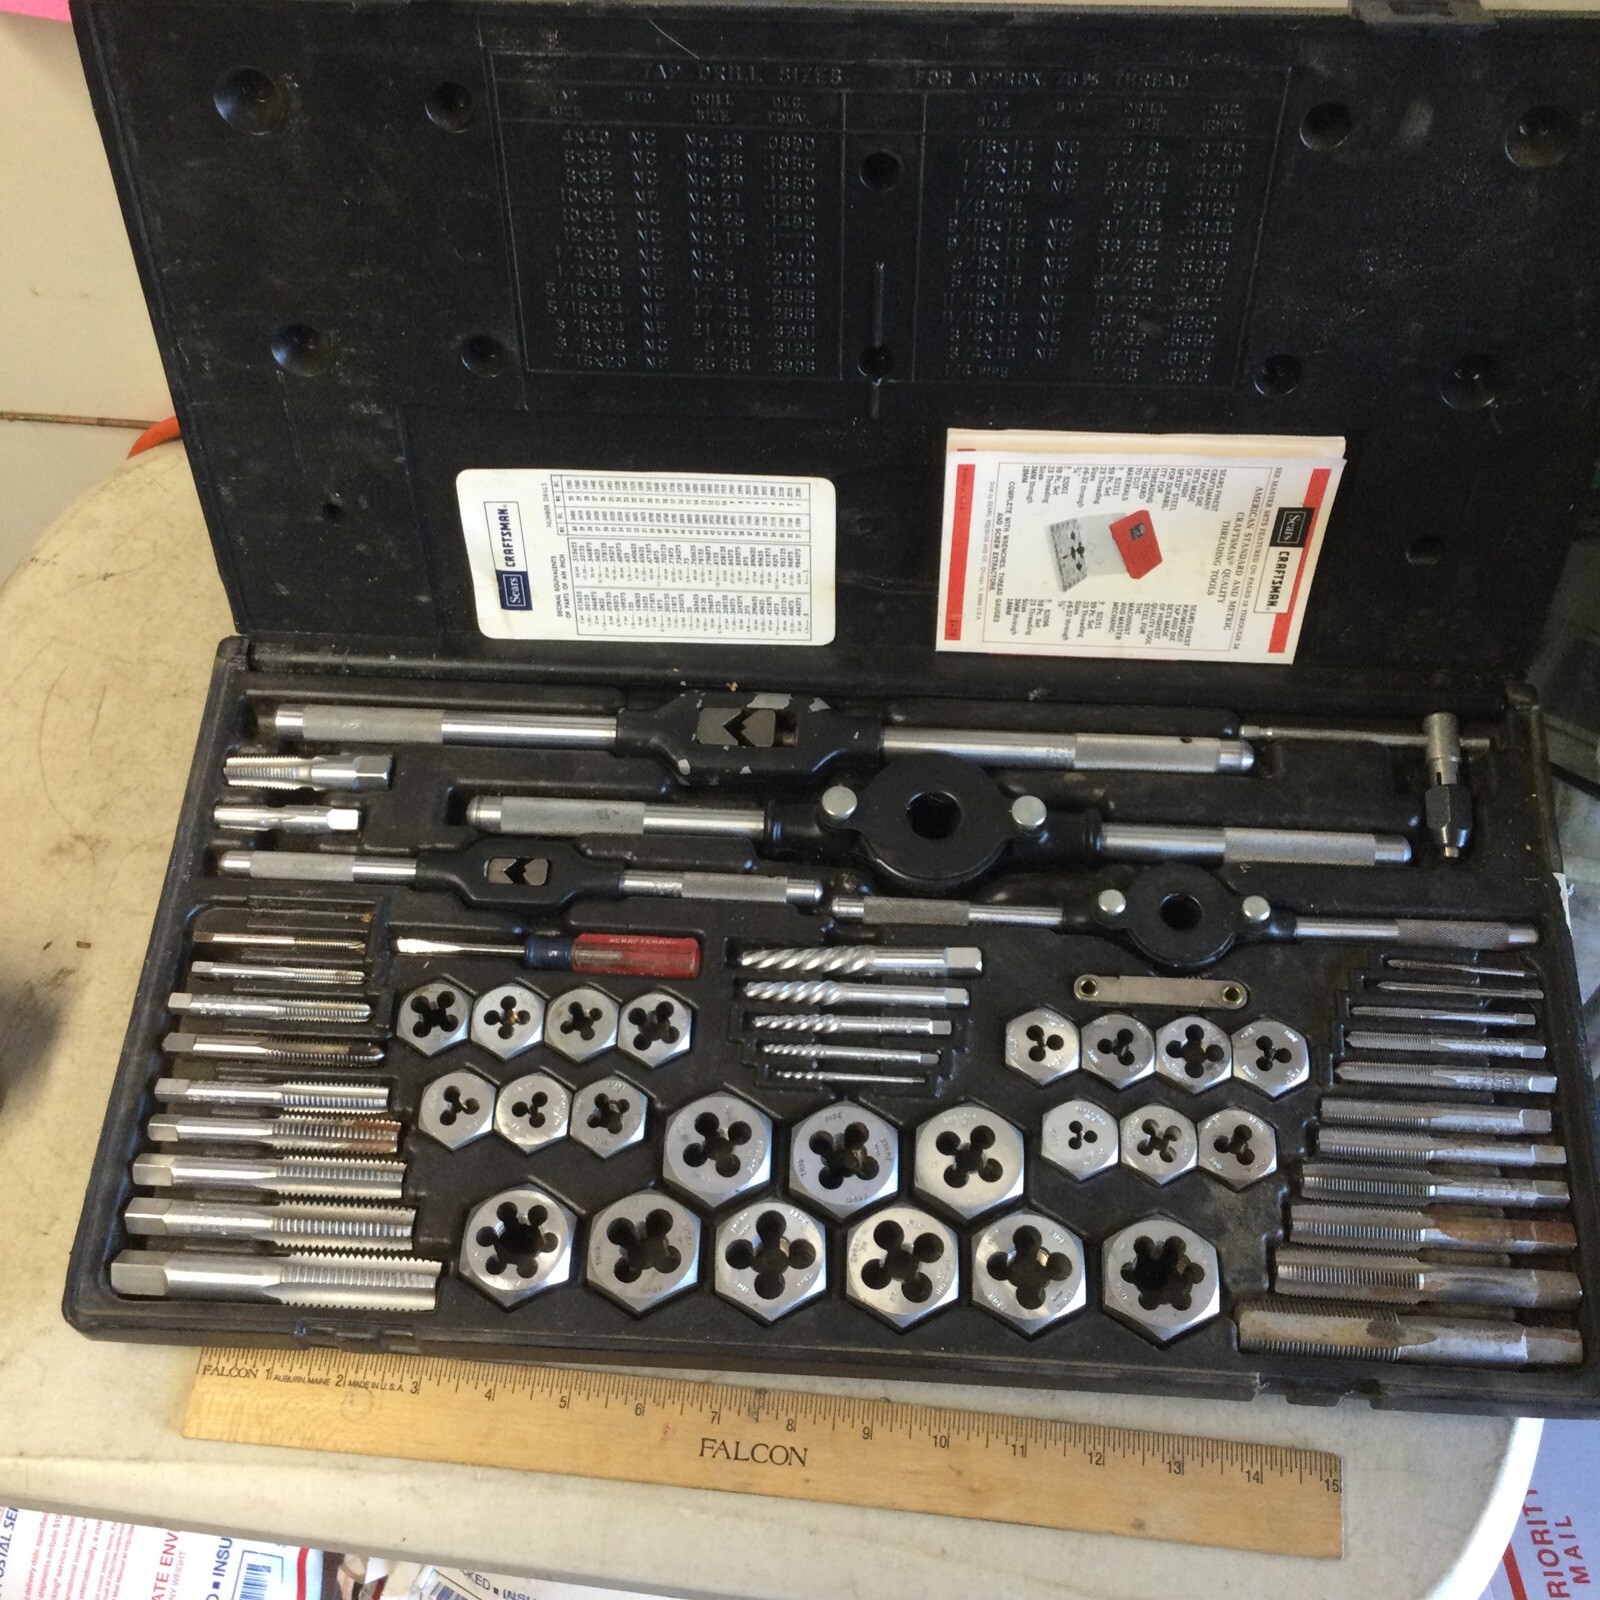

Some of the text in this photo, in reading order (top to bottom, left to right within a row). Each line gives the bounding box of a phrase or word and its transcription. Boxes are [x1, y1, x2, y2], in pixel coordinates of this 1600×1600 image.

[1121, 466, 1134, 501] MATERIALS
[1131, 467, 1142, 489] TO CUT
[1138, 467, 1150, 499] THE HARD
[1145, 467, 1159, 503] THREADING
[1156, 480, 1164, 493] FOR
[1166, 467, 1176, 480] FOR
[1184, 468, 1192, 476] OF
[1187, 468, 1201, 502] SETS MADE
[1194, 468, 1209, 506] TAP AND DIE
[1004, 481, 1015, 514] COMPLETE
[1041, 474, 1053, 503] Threading
[1075, 485, 1086, 507] through
[1092, 476, 1105, 504] Threading
[1168, 493, 1179, 511] STEEL
[1210, 469, 1226, 511] SEARS FINEST
[1264, 480, 1278, 507] MASTER
[543, 504, 552, 526] NUMBER
[995, 512, 1003, 524] AND
[1003, 517, 1011, 532] WITH
[1260, 510, 1270, 526] SETS
[992, 528, 1001, 548] SCREW
[1251, 528, 1266, 562] FEATURED
[497, 508, 521, 603] Sears CRAFTSMAN
[1206, 520, 1230, 595] THREADING TOOLS
[1222, 486, 1263, 630] AMERICAN STANDARD AND METRIC
[1249, 565, 1257, 574] ON
[1265, 514, 1302, 607] Sears CRAFTSMAN
[550, 555, 563, 616] DECIMAL EQUIVALENTS
[995, 572, 1004, 595] THREAD
[1216, 568, 1232, 603] QUALITY
[1243, 577, 1254, 598] PAGES
[565, 610, 571, 618] OF
[992, 598, 1001, 622] GAUGES
[1076, 610, 1088, 637] Threading
[1108, 602, 1119, 633] MECHANIC
[1114, 602, 1127, 640] AND MASTER
[1123, 602, 1134, 635] MACHINIST
[1134, 602, 1142, 614] THE
[1138, 602, 1150, 634] STEEL FOR
[1144, 602, 1158, 645] QUALITY TOOL
[1153, 603, 1166, 639] OF HIGHEST
[1161, 603, 1174, 637] SETS MADE
[1170, 617, 1179, 630] AND
[1173, 604, 1181, 615] TAP
[1182, 604, 1197, 646] SEARS FINEST
[1234, 609, 1247, 640] THROUGH
[202, 1364, 260, 1380] FALCON
[348, 1380, 370, 1390] MADE
[334, 1373, 344, 1388] 2
[410, 1380, 419, 1395] 3
[484, 1389, 493, 1402] 4
[558, 1396, 568, 1410] 5
[634, 1403, 643, 1417] 6
[710, 1410, 719, 1425] 7
[785, 1418, 795, 1433] 8
[862, 1426, 871, 1441] 9
[932, 1433, 947, 1449] 10
[1011, 1443, 1025, 1458] 11
[1088, 1451, 1102, 1466] 12
[1166, 1460, 1182, 1475] 13
[1245, 1469, 1260, 1484] 14
[1324, 1478, 1340, 1493] 15
[699, 1437, 808, 1467] FALCON
[1555, 1515, 1591, 1585] MAIL
[173, 1551, 186, 1586] WEIGHT
